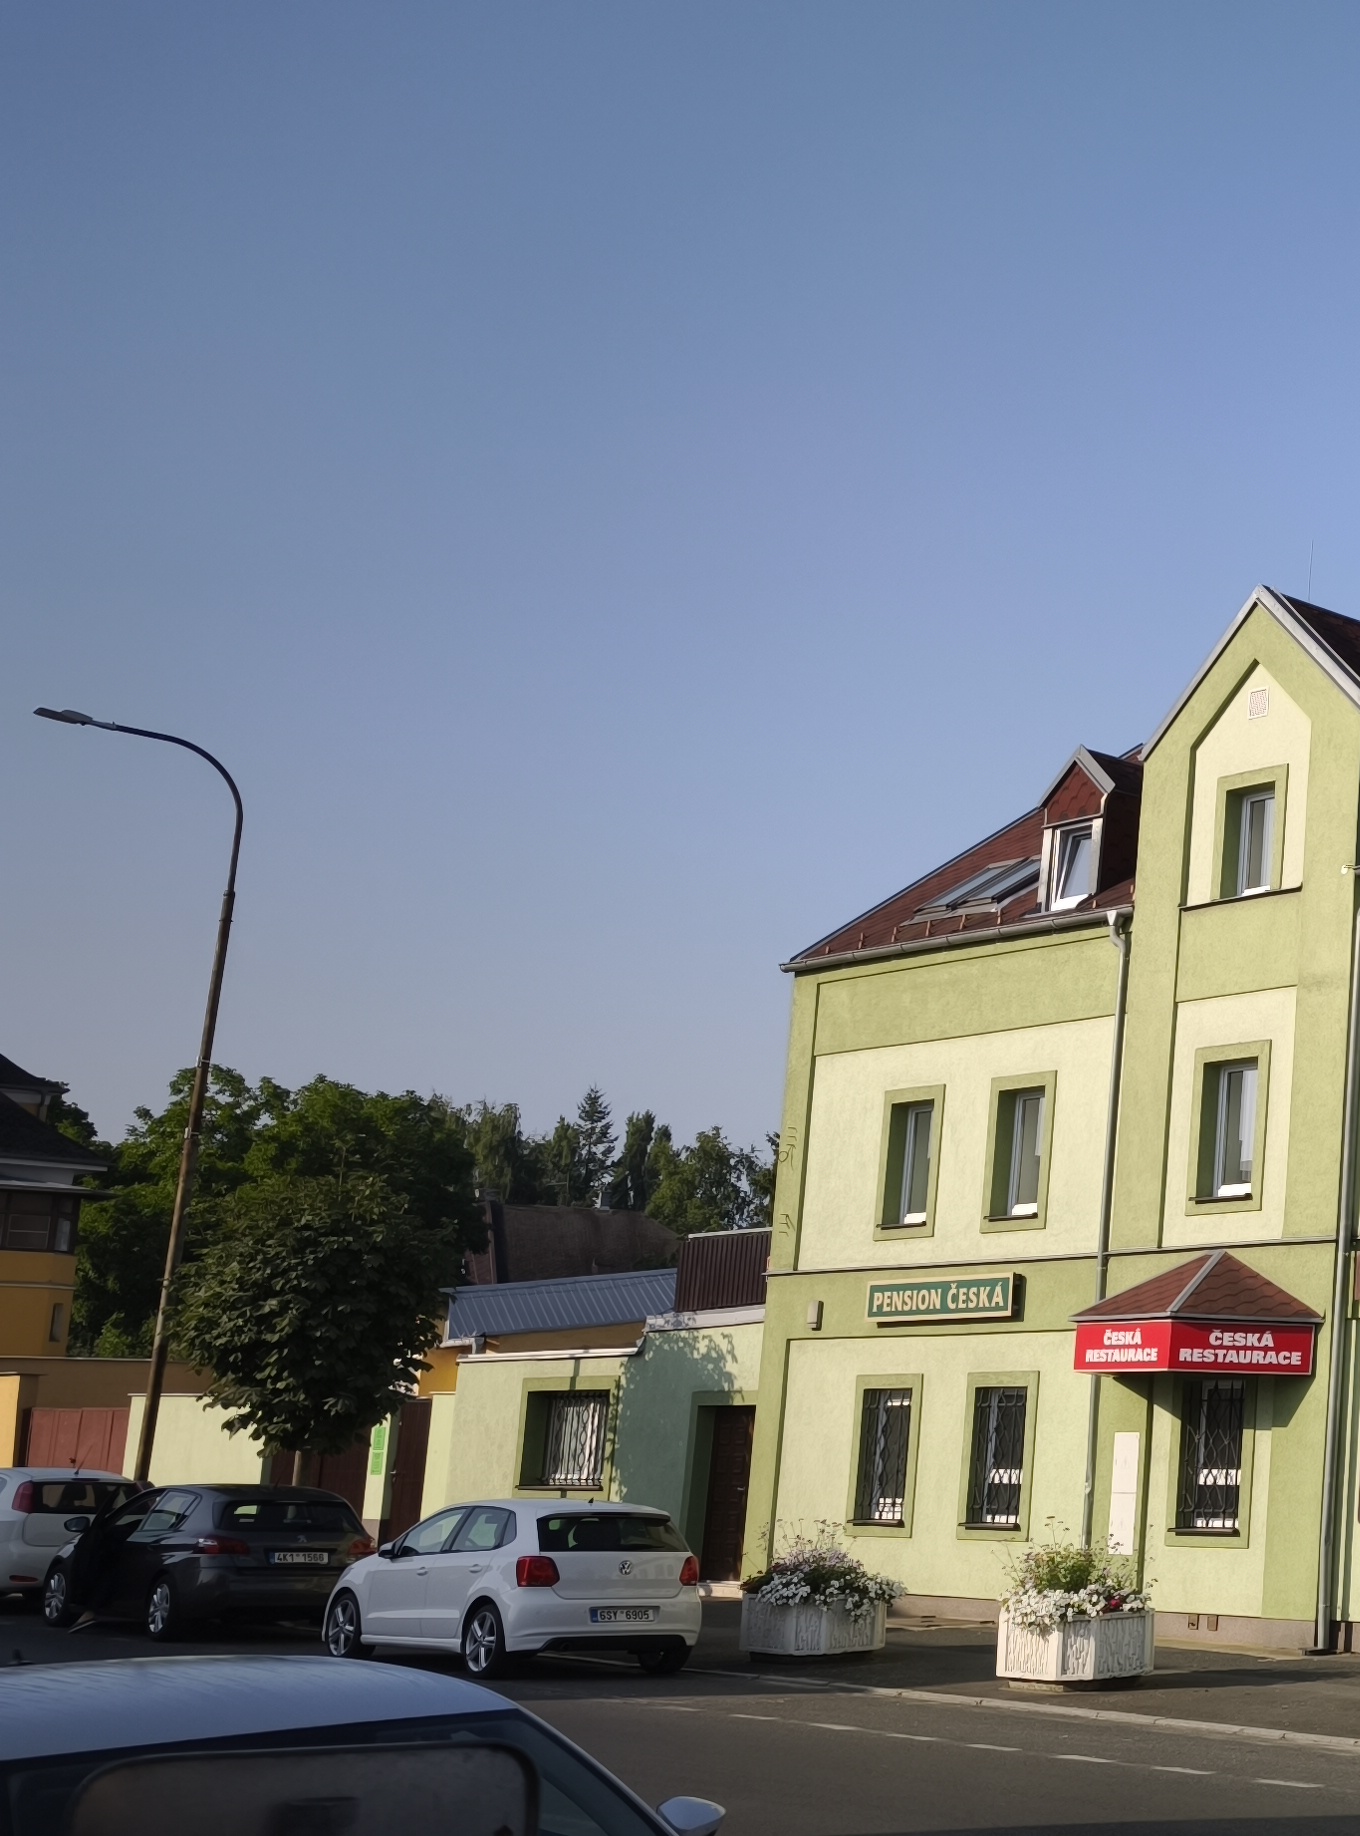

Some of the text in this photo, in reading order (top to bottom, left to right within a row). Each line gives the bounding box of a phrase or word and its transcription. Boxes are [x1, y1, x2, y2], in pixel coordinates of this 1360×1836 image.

[872, 1282, 1005, 1313] PENSION ČESKÁ
[1103, 1327, 1143, 1346] ČESKÁ
[1208, 1329, 1275, 1348] ČESKÁ
[1085, 1347, 1159, 1363] RESTAURACE
[1178, 1348, 1302, 1365] RESTAURACE
[600, 1609, 650, 1620] 6SY 6905
